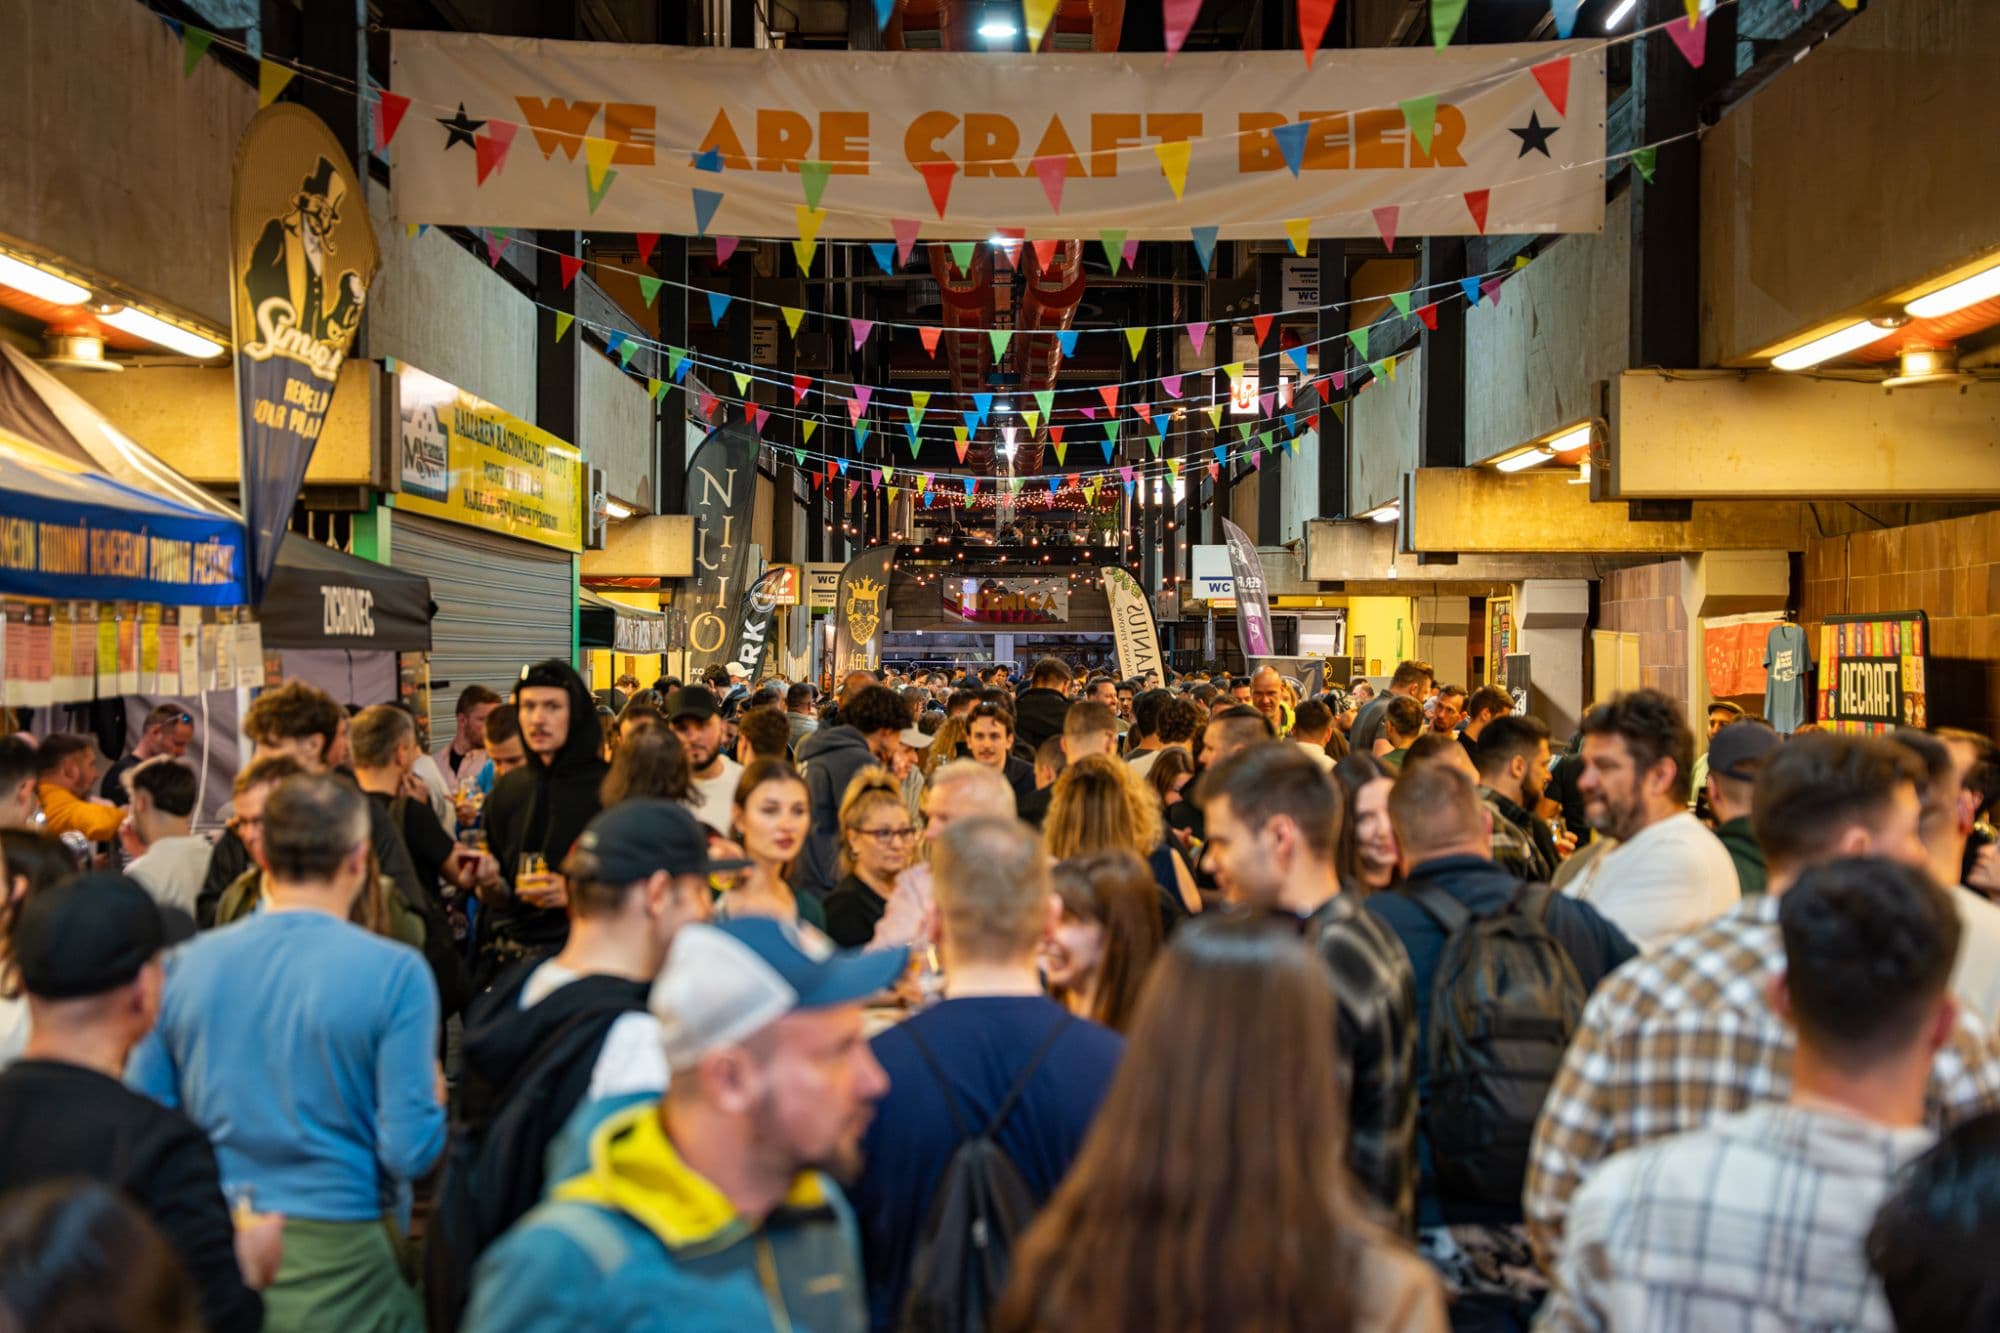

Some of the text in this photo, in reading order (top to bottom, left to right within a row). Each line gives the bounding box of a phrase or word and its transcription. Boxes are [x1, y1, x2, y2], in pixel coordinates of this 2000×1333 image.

[514, 96, 1468, 178] WE ARE CRAFT BEER
[1298, 291, 1318, 301] WC
[817, 575, 836, 585] WC
[1208, 582, 1231, 593] WC
[320, 585, 375, 637] ZICHOVEC
[1840, 662, 1898, 717] RECRAFT
